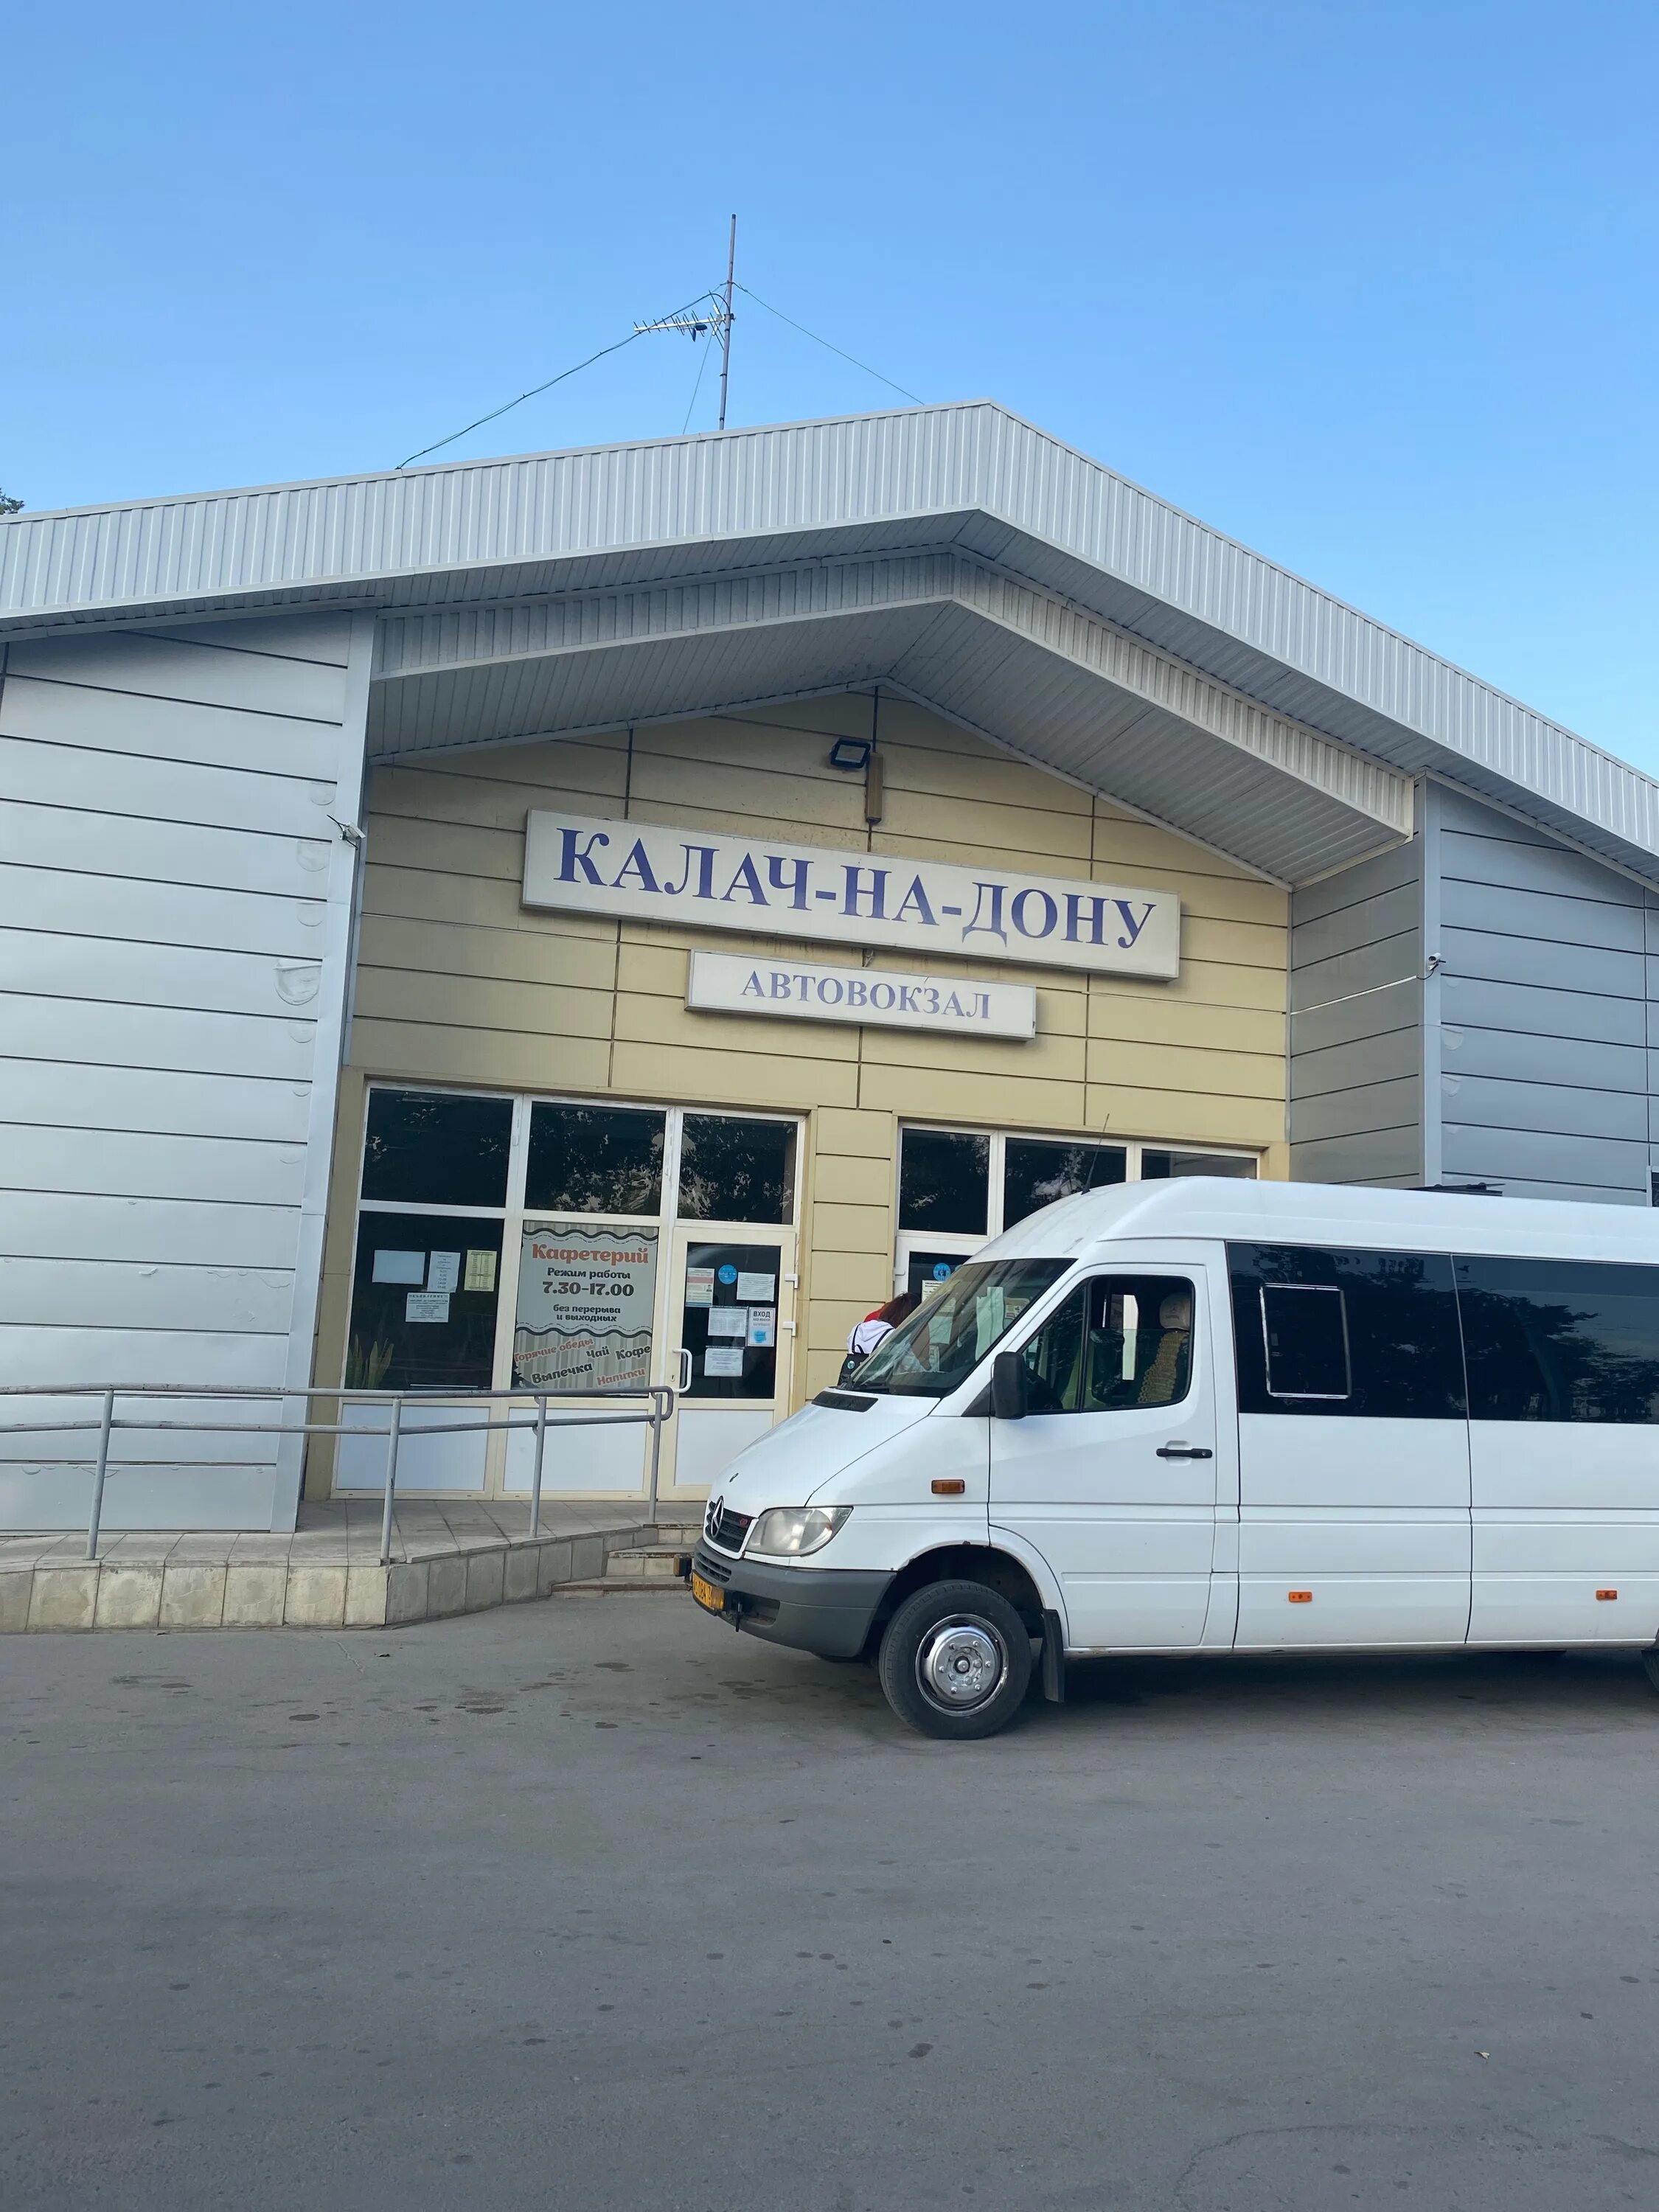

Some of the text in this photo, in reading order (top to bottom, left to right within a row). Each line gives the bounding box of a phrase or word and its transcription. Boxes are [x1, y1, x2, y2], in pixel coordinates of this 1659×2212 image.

[553, 827, 1157, 950] КАЛАЧ-НА-ДОНУ
[740, 970, 992, 1020] АВТОВОКЗАЛ
[532, 1243, 649, 1266] Кафетерий
[547, 1267, 631, 1280] Режим работы
[542, 1281, 634, 1297] 7.30-17.00
[553, 1304, 621, 1315] без перерыва
[514, 1338, 594, 1363] Горячие обеды
[585, 1346, 610, 1359] Чай
[616, 1346, 651, 1360] Кофе
[532, 1363, 593, 1385] Выпечка
[597, 1368, 646, 1386] Напитки
